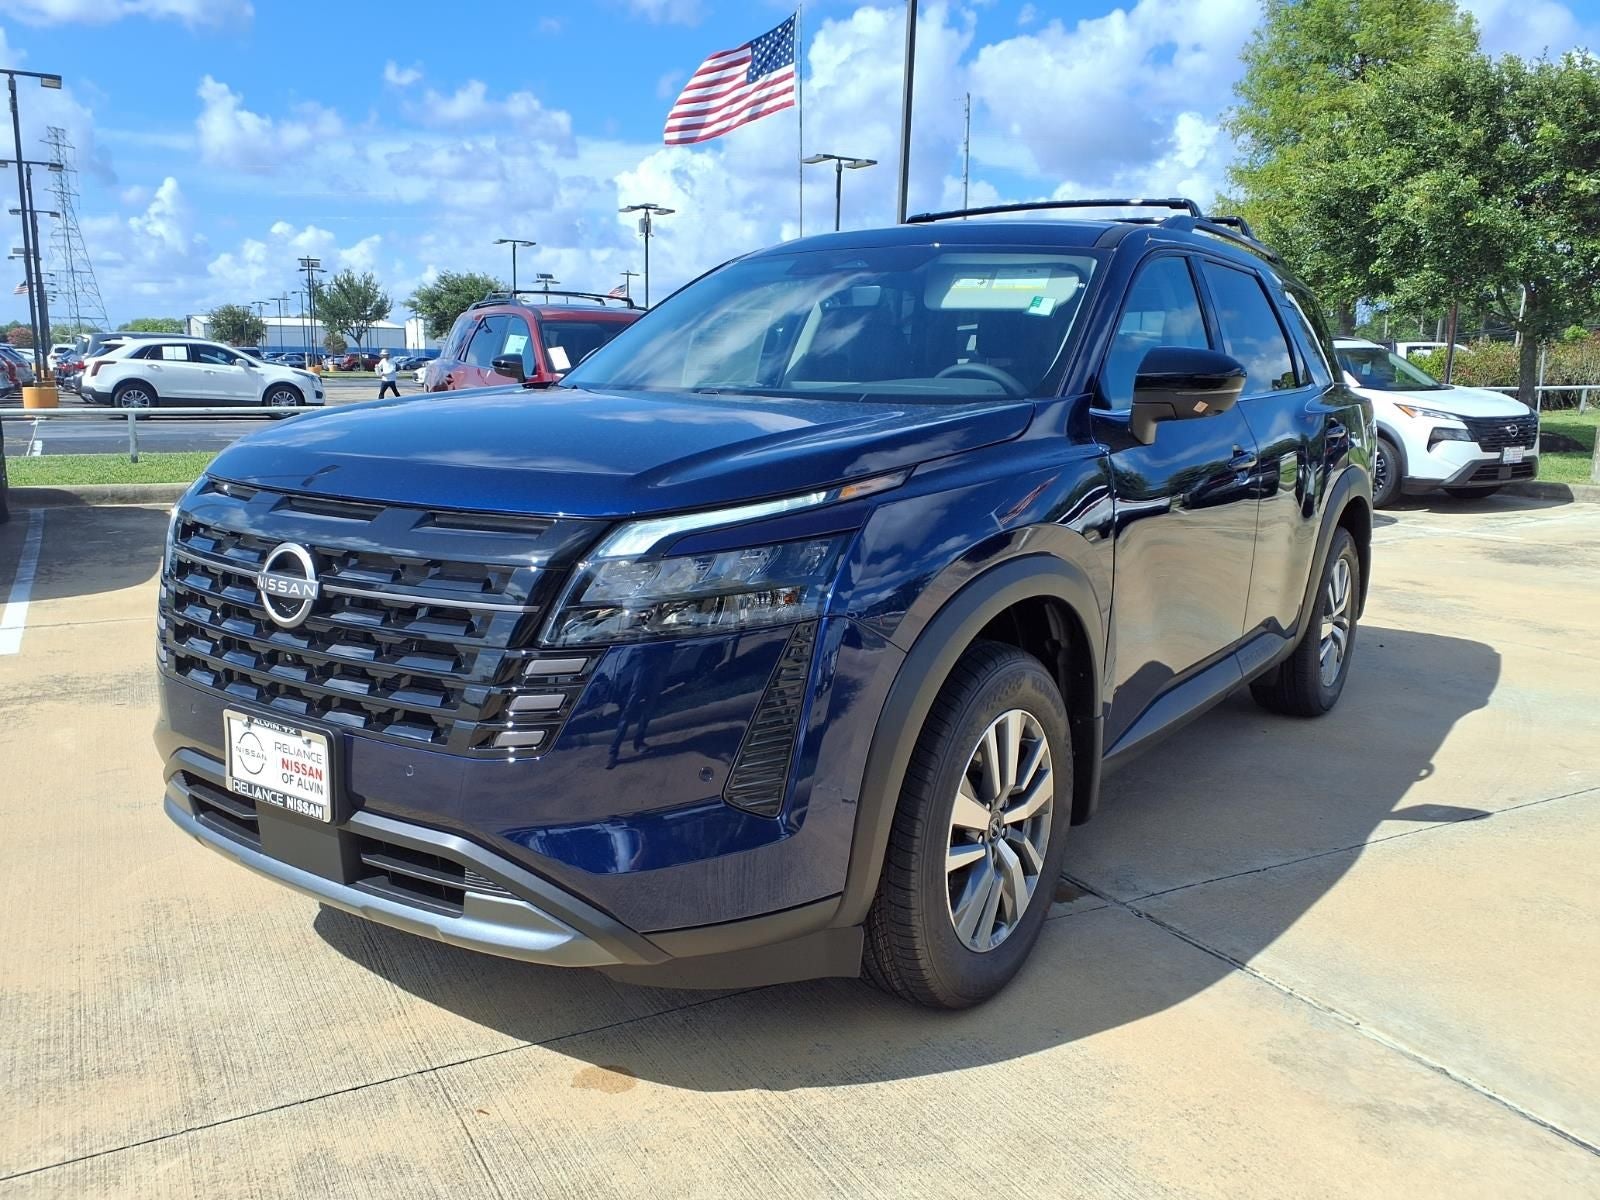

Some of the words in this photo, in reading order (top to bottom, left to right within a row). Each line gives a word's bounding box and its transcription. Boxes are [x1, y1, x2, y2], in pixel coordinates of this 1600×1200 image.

[257, 575, 316, 597] NISSAN
[282, 726, 296, 735] TX
[235, 745, 267, 761] NISSAN
[274, 741, 323, 765] RELIANCE
[281, 757, 323, 782] NISSAN
[281, 772, 295, 785] OF
[297, 778, 323, 796] ALVIN
[233, 780, 284, 806] RELIANCE
[286, 795, 323, 820] NISSAN
